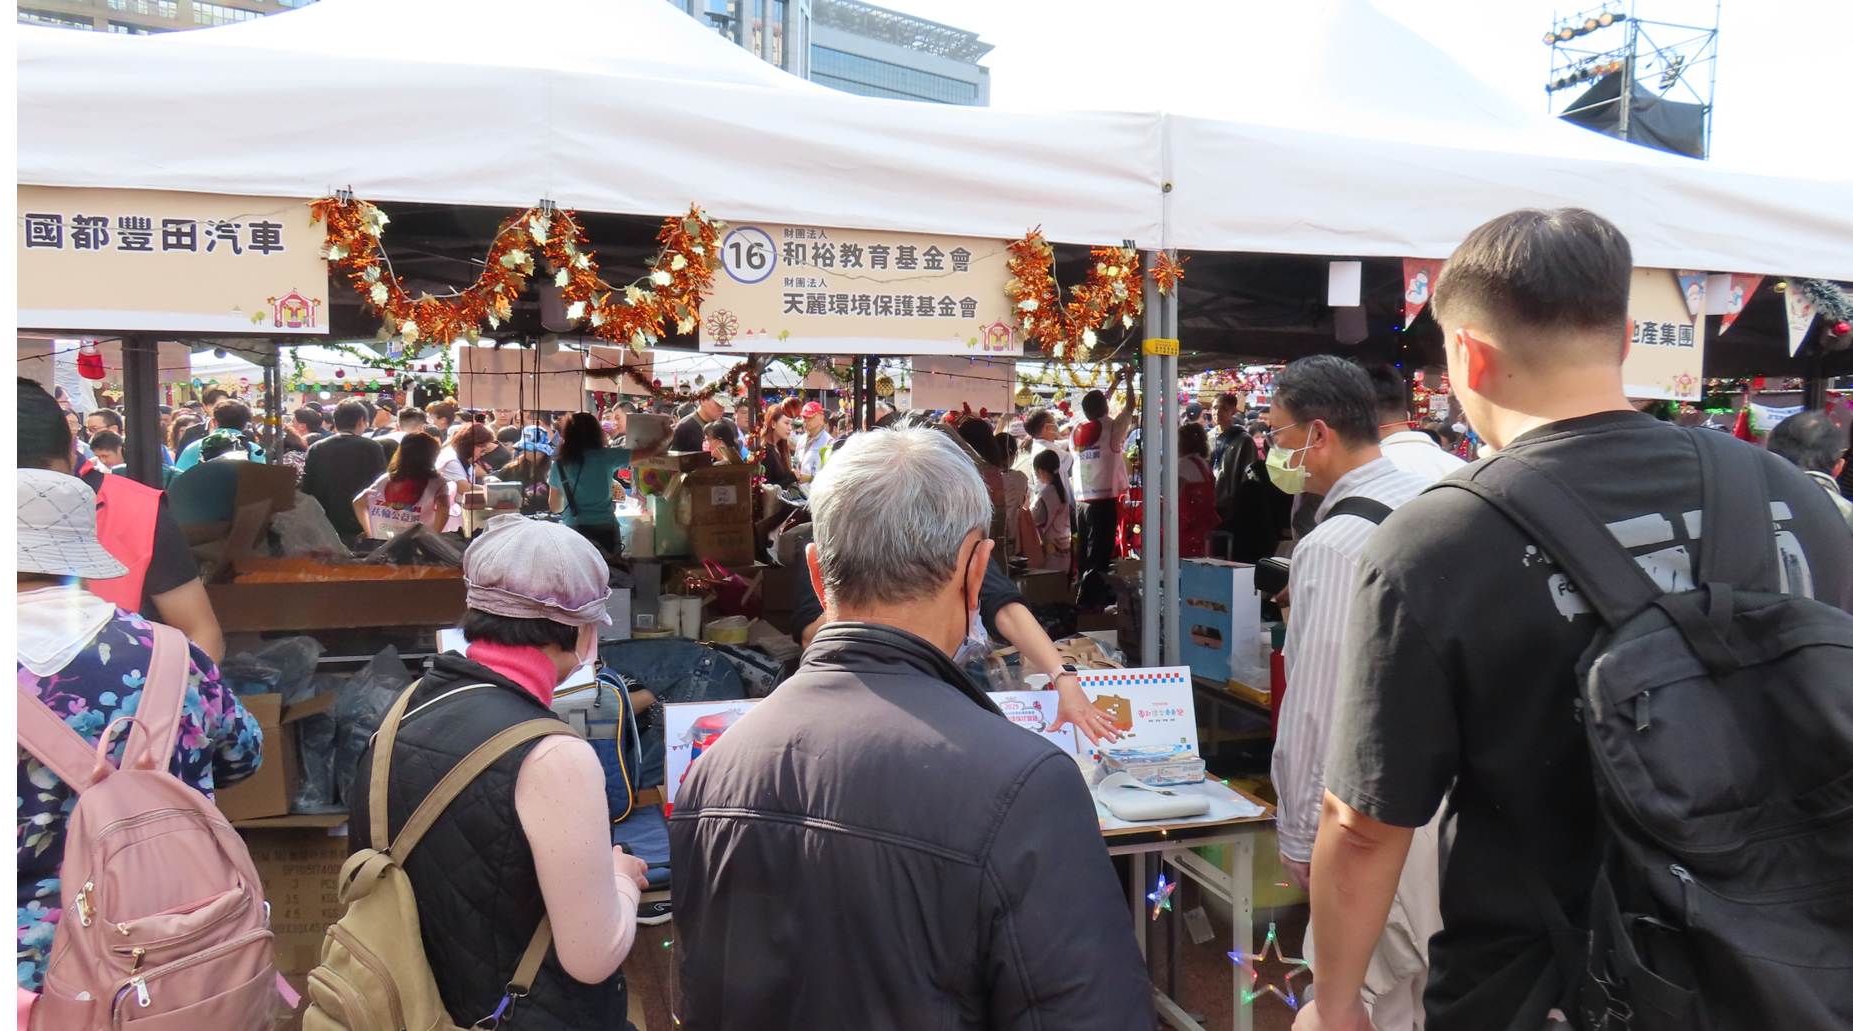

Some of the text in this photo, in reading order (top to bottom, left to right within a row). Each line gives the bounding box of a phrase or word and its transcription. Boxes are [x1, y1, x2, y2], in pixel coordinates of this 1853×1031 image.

[25, 213, 284, 255] 國都豐田汽車
[784, 228, 828, 240] 財團法人
[729, 241, 766, 270] 16
[783, 240, 972, 272] 和裕教育基金會
[784, 277, 828, 288] 財團法人
[783, 293, 978, 319] 天麗環境保護基金會
